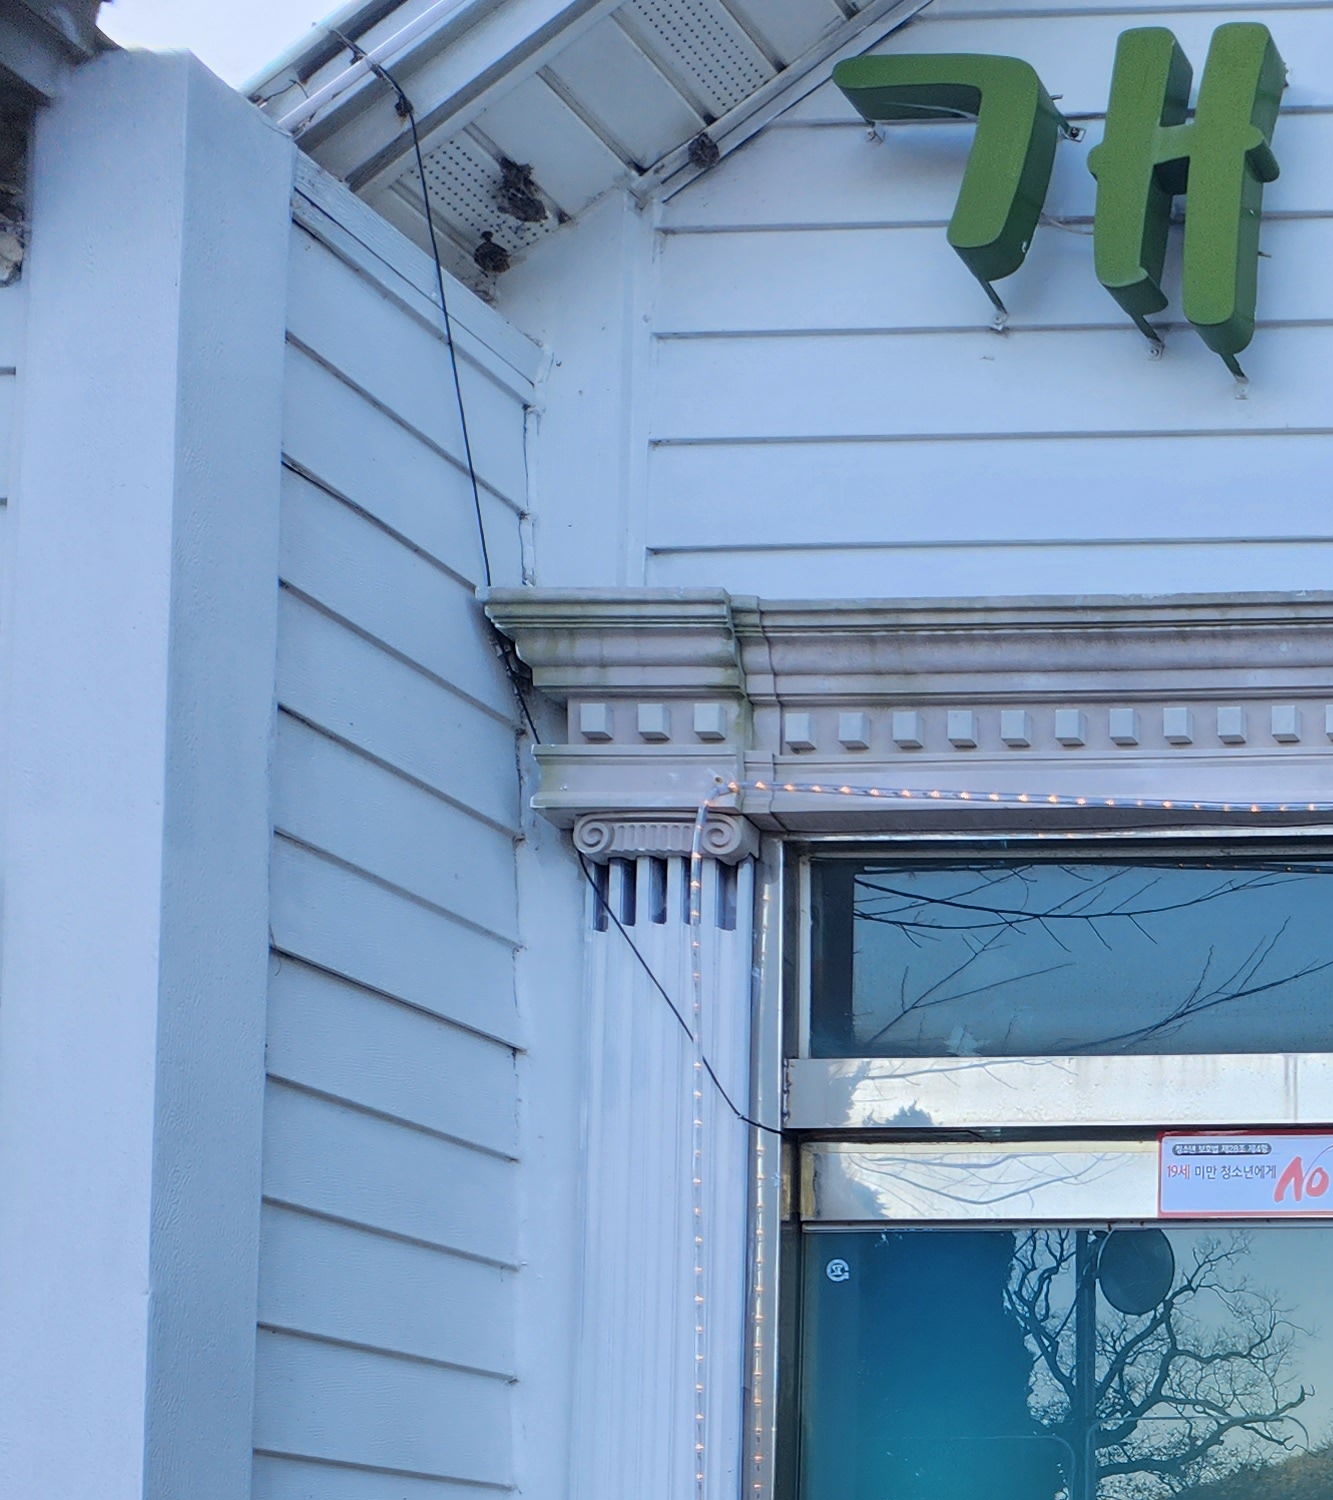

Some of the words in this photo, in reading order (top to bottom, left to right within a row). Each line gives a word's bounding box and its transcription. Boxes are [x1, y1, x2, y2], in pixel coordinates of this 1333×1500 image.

[1167, 1164, 1190, 1179] 19세
[1194, 1165, 1217, 1180] 미만
[1220, 1164, 1277, 1180] 청소년에게
